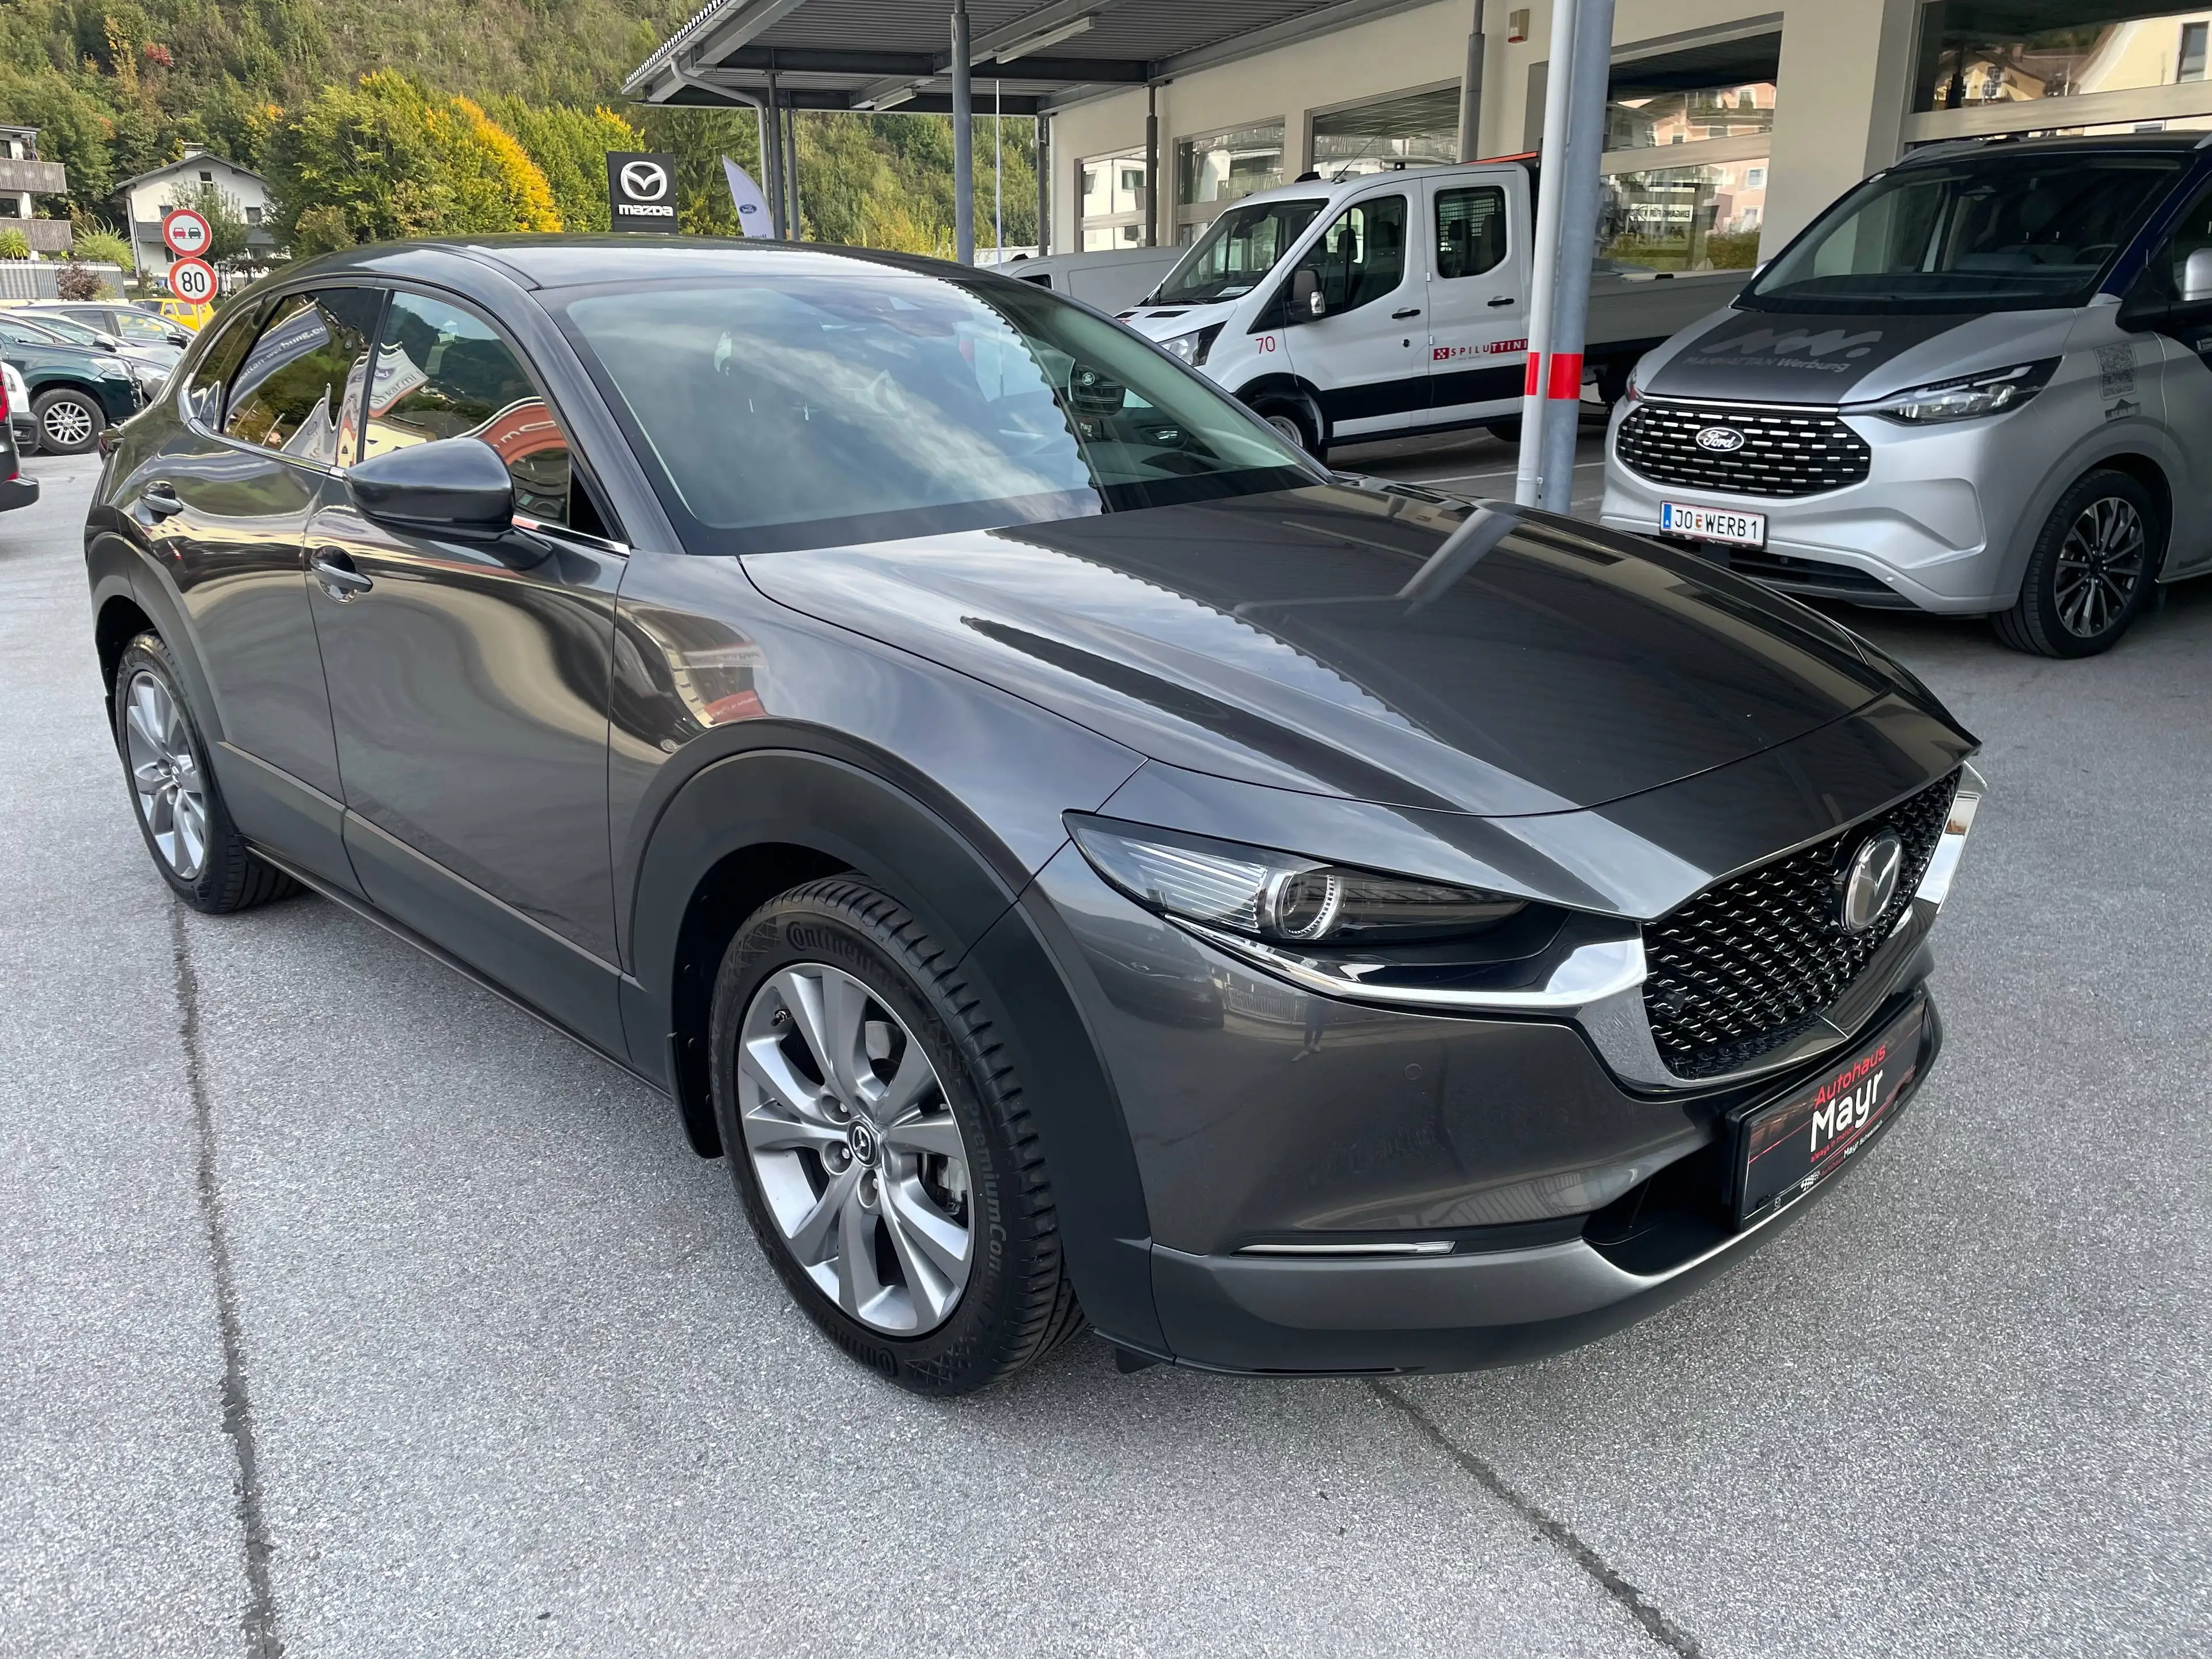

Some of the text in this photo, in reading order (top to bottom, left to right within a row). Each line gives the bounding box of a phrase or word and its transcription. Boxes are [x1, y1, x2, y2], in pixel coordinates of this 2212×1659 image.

[618, 204, 673, 217] mazda
[181, 271, 205, 292] 80
[1255, 336, 1275, 354] 70
[1450, 340, 1528, 357] SPILUTTINI
[1777, 358, 1851, 373] Werbung
[1703, 430, 1736, 448] Ford
[1675, 509, 1692, 529] JO
[1705, 513, 1746, 537] WERB
[1815, 1044, 1887, 1109] Autohaus
[1810, 1069, 1883, 1152] Mayr
[1843, 1141, 1859, 1158] Mayr
